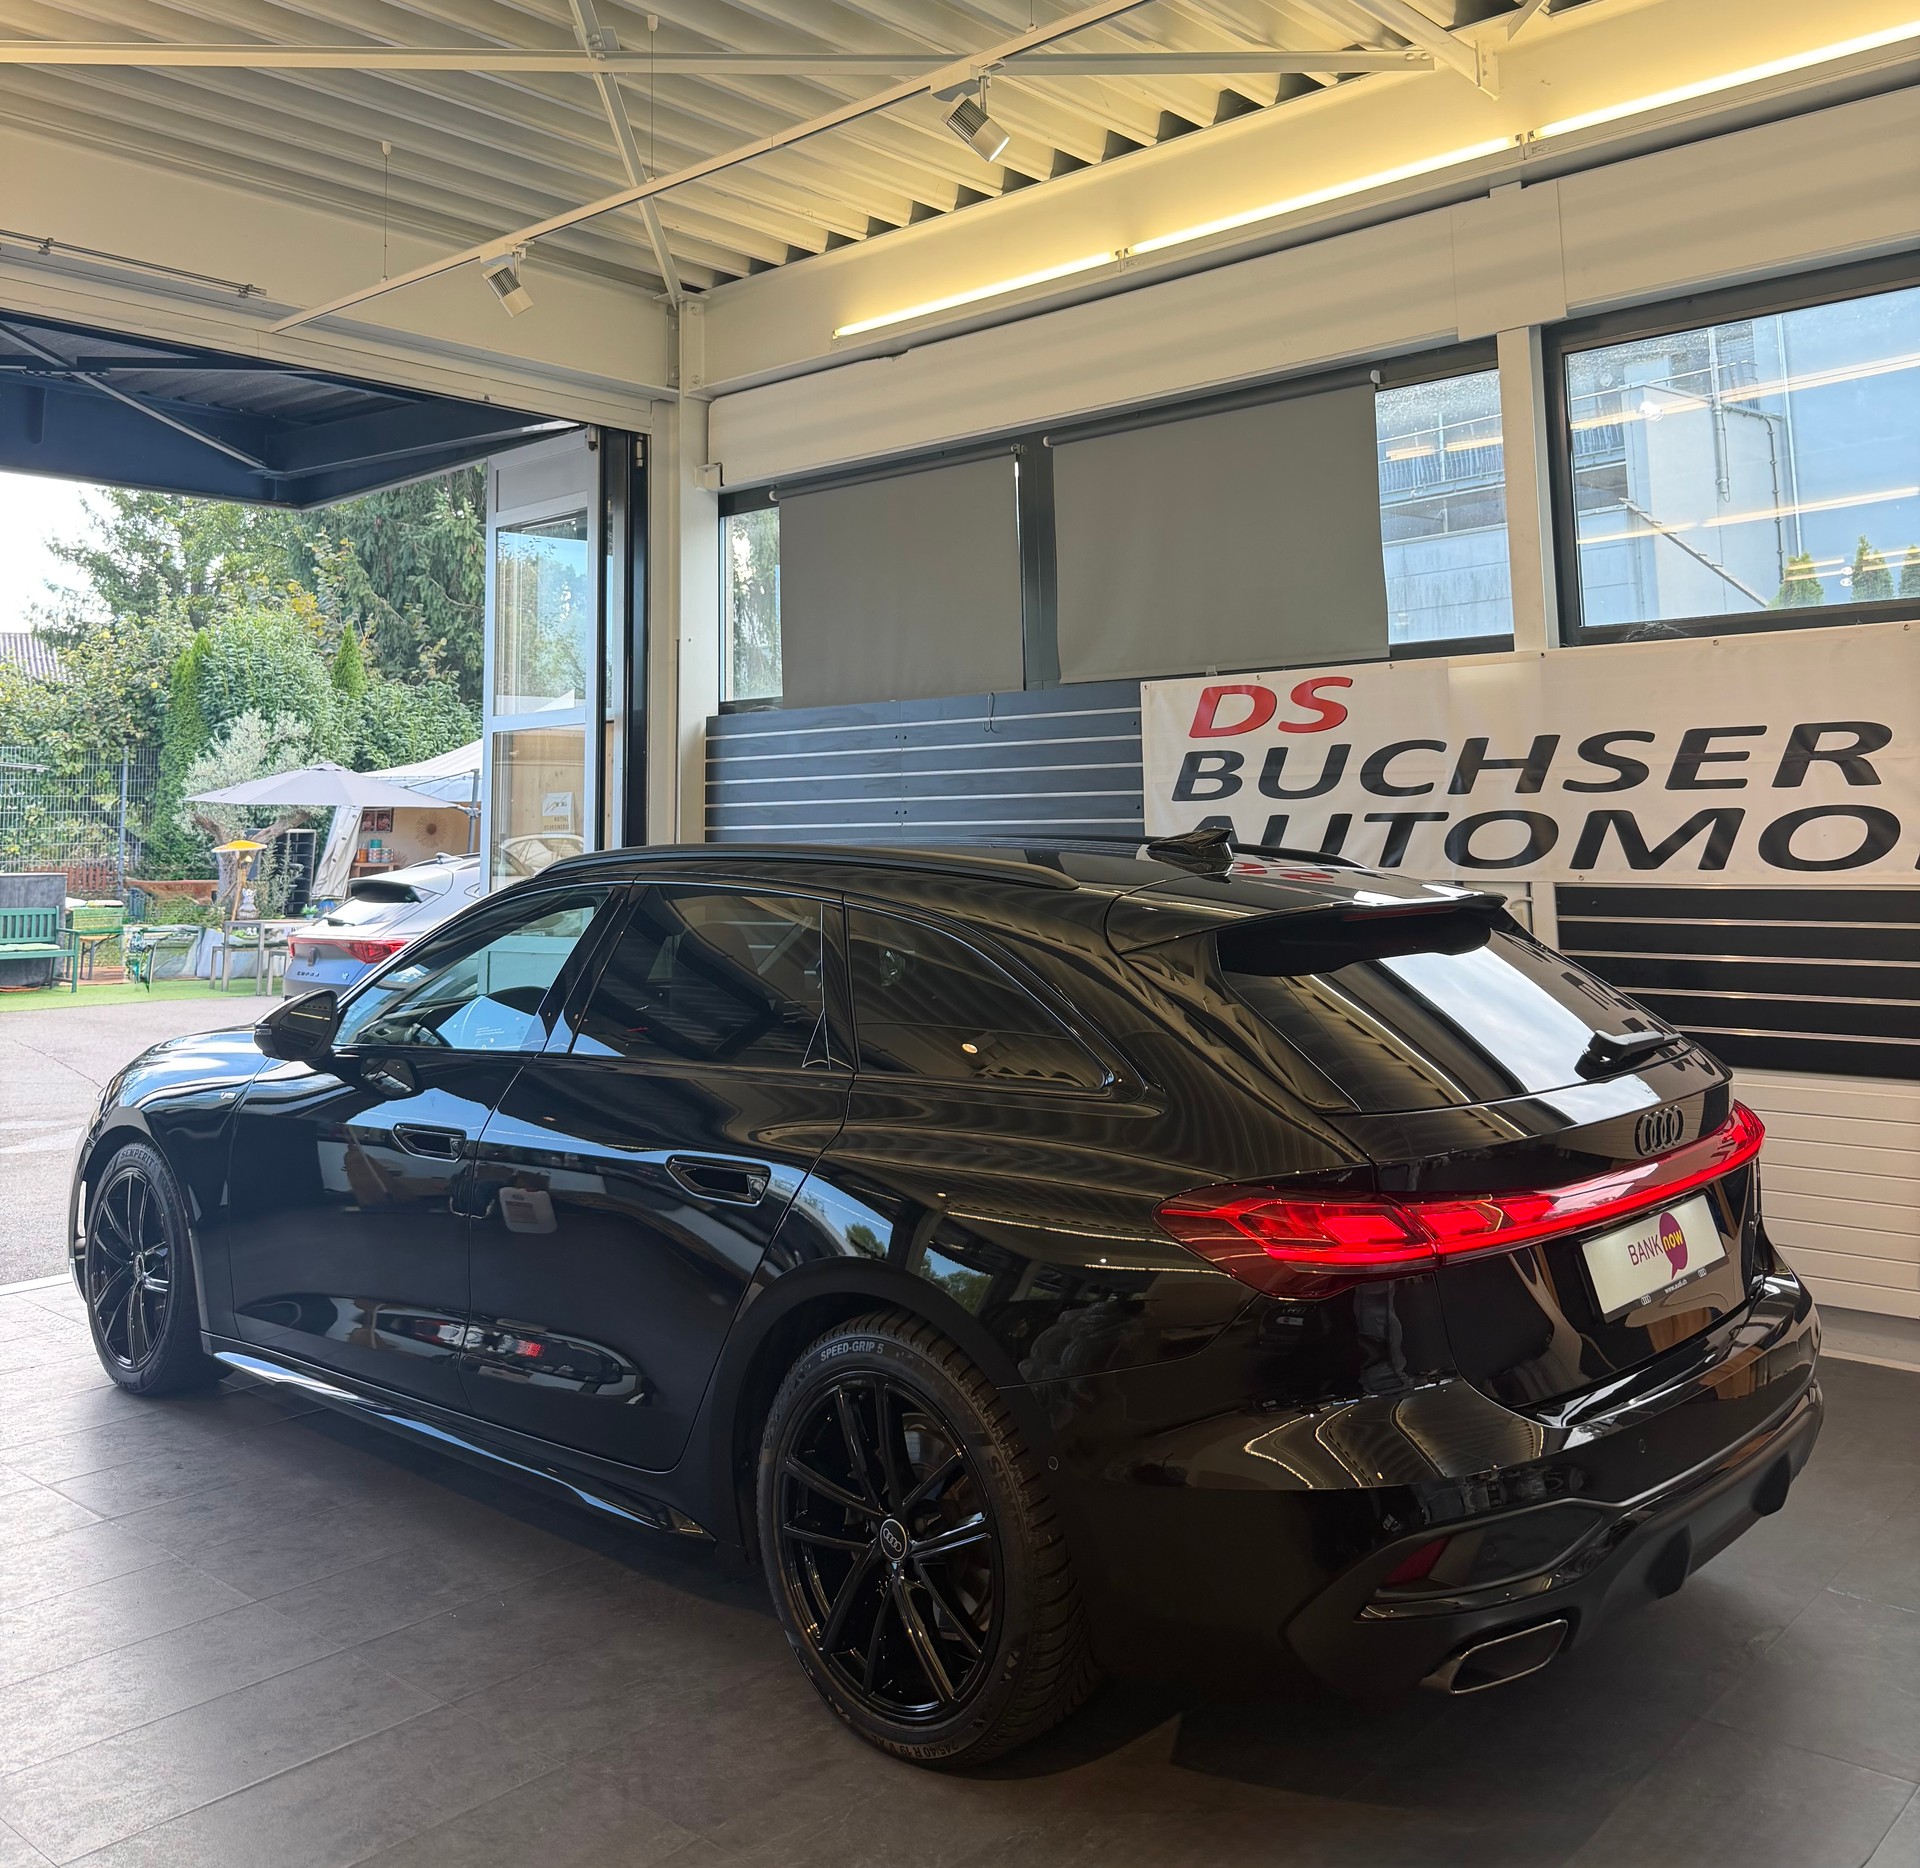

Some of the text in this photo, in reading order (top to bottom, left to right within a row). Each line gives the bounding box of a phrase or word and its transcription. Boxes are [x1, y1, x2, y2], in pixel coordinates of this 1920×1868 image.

[1188, 676, 1354, 738] DS
[1171, 721, 1893, 802] BUCHSER
[1627, 1229, 1684, 1266] BANK now
[820, 1340, 885, 1362] SPEED-GRIP 5
